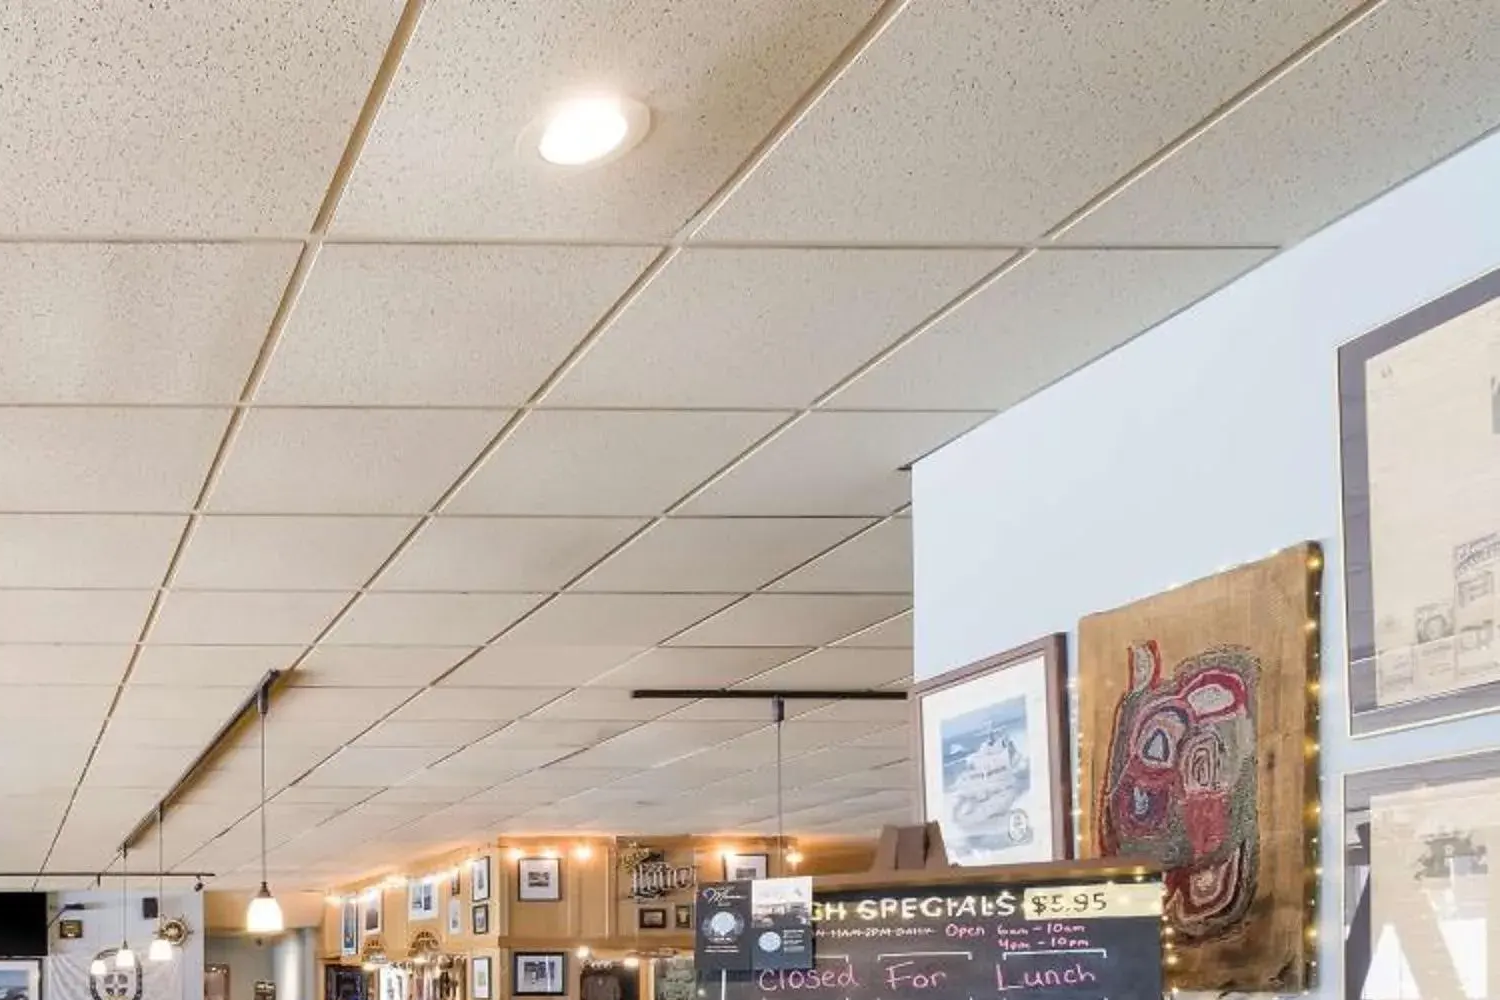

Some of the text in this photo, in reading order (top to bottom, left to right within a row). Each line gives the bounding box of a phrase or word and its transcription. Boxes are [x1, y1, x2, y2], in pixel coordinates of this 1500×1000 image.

[857, 892, 1017, 920] SPECIALS
[1031, 892, 1108, 915] $5.95
[945, 923, 986, 939] Open
[997, 924, 1029, 936] 6am
[1047, 922, 1086, 935] 10am
[998, 938, 1031, 951] 4pm
[1051, 937, 1090, 949] 10pm
[759, 961, 1096, 991] Closed For Lunch
